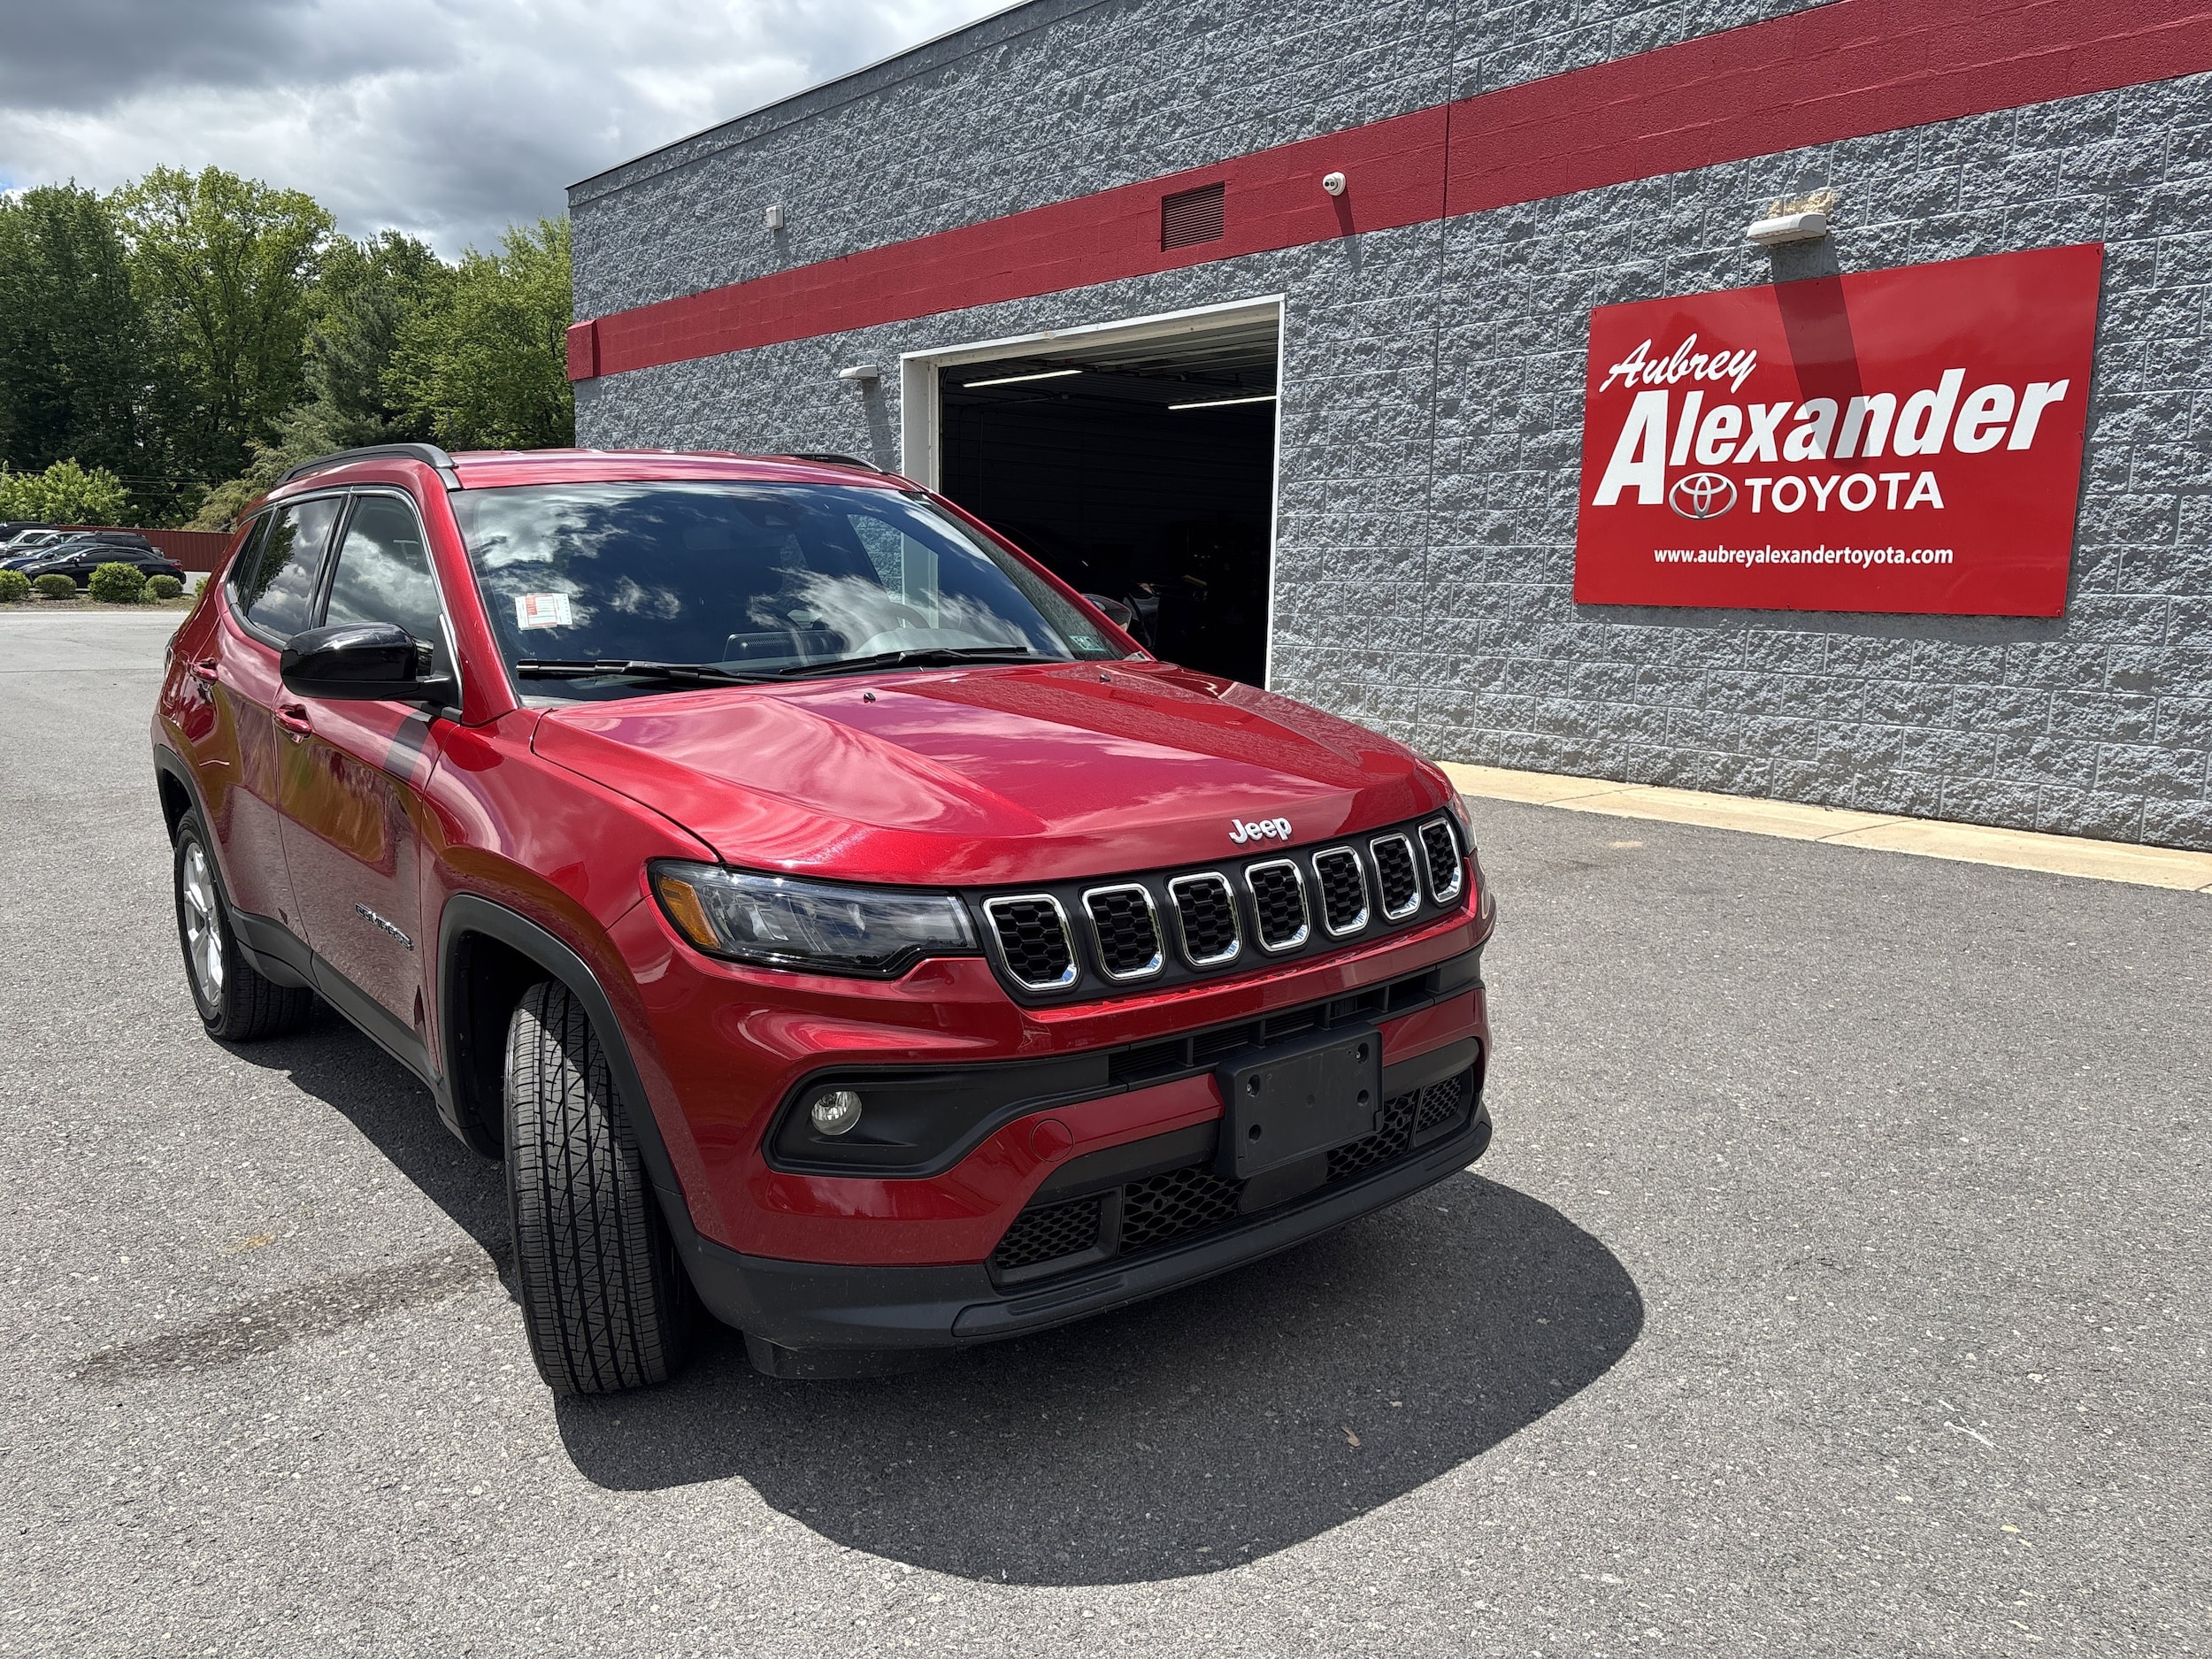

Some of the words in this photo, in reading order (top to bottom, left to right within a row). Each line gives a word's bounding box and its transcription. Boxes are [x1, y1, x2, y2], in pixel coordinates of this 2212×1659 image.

[1599, 333, 1757, 395] Aubrey
[1592, 367, 2070, 506] Alexander
[1745, 472, 1945, 513] TOYOTA
[1654, 545, 1954, 569] www.aubreyalexandertoyota.com
[1228, 817, 1293, 844] Jeep
